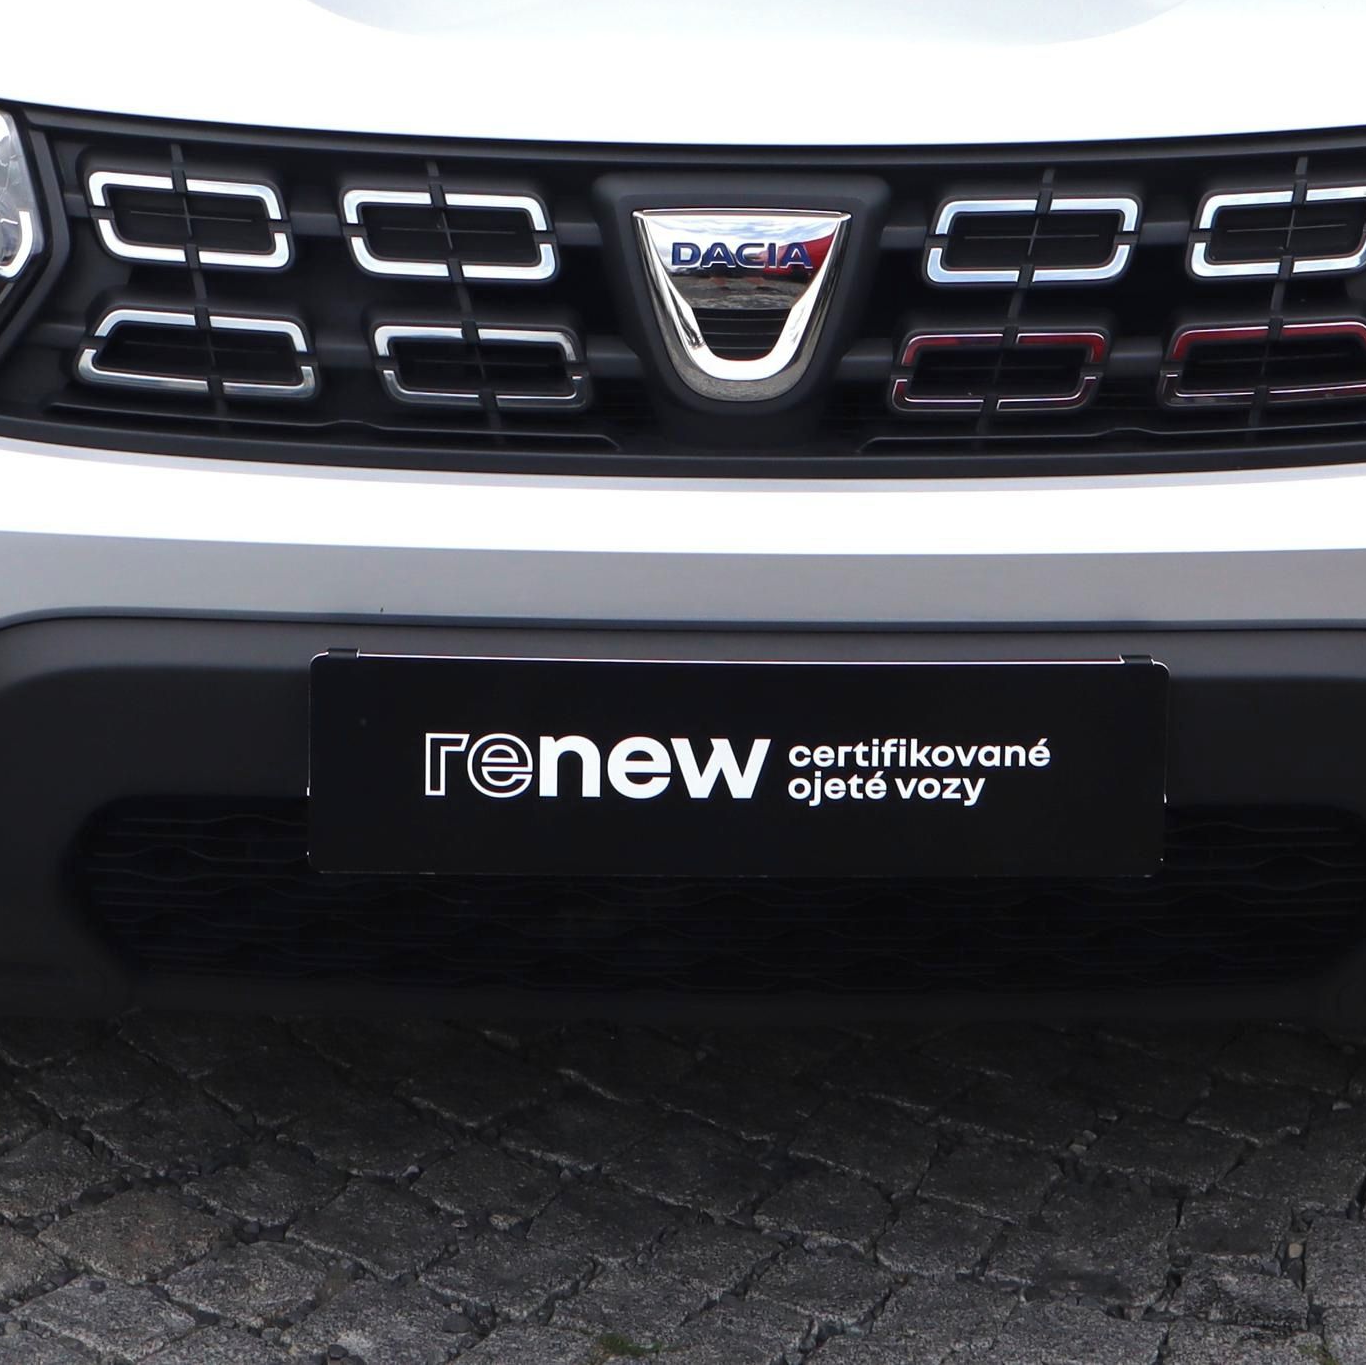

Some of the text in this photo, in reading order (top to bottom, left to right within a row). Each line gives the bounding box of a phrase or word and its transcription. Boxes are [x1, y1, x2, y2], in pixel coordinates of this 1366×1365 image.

[671, 242, 813, 269] DACIA
[424, 730, 772, 799] renew
[788, 735, 1051, 769] certifikované
[788, 768, 986, 808] ojeté vozy
